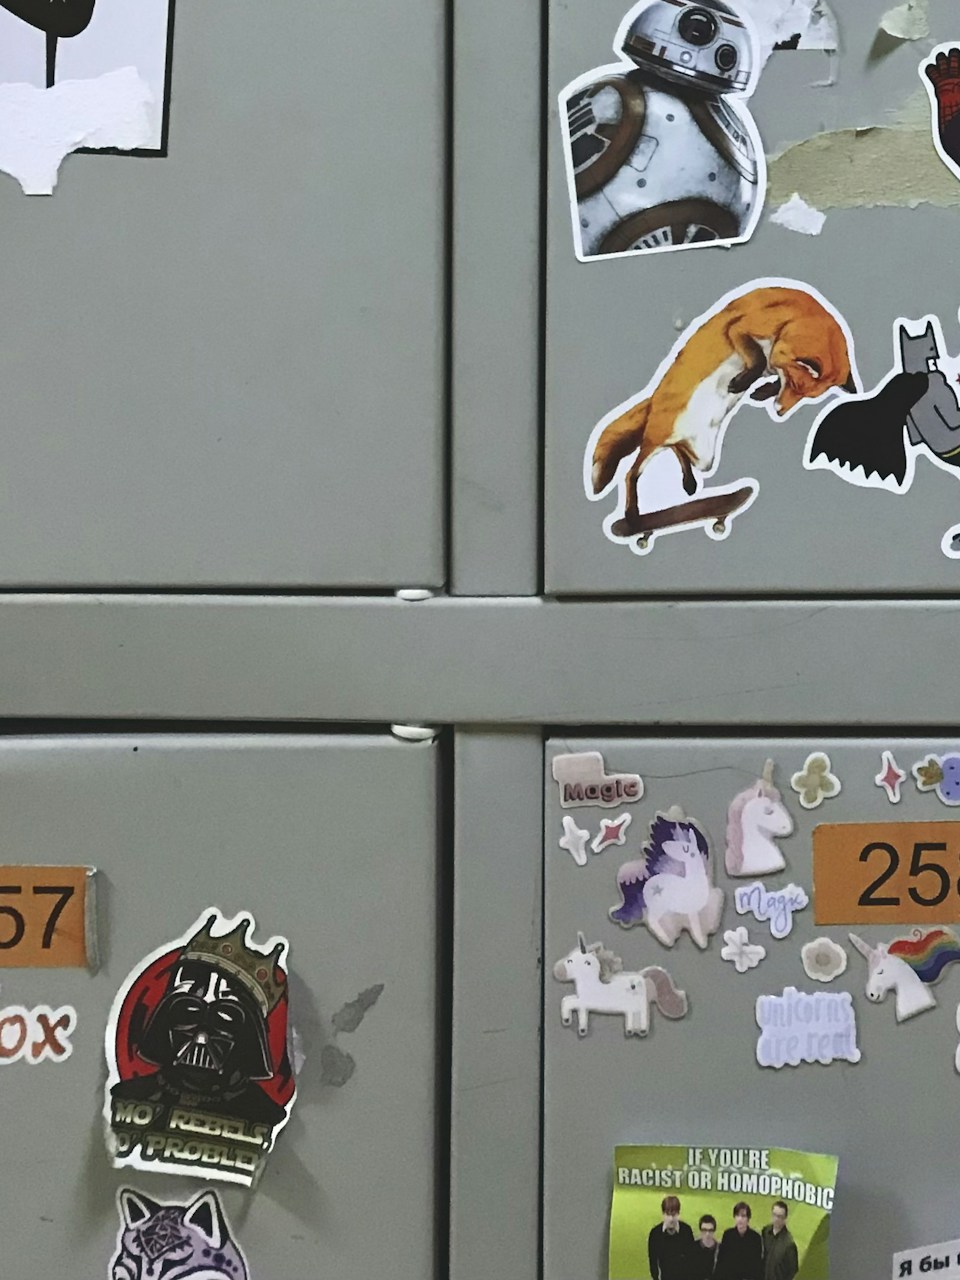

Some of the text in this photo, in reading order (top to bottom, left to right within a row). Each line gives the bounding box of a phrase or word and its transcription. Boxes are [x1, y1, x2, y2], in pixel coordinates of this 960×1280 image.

[563, 779, 639, 803] Magic
[115, 1101, 270, 1150] MO' REBELS,
[688, 1148, 770, 1170] IF YOU'RE
[618, 1167, 683, 1189] RACIST
[687, 1170, 712, 1190] OR
[717, 1173, 835, 1211] HOMOPHOBIC
[898, 1259, 912, 1277] Я
[919, 1255, 950, 1273] бы
